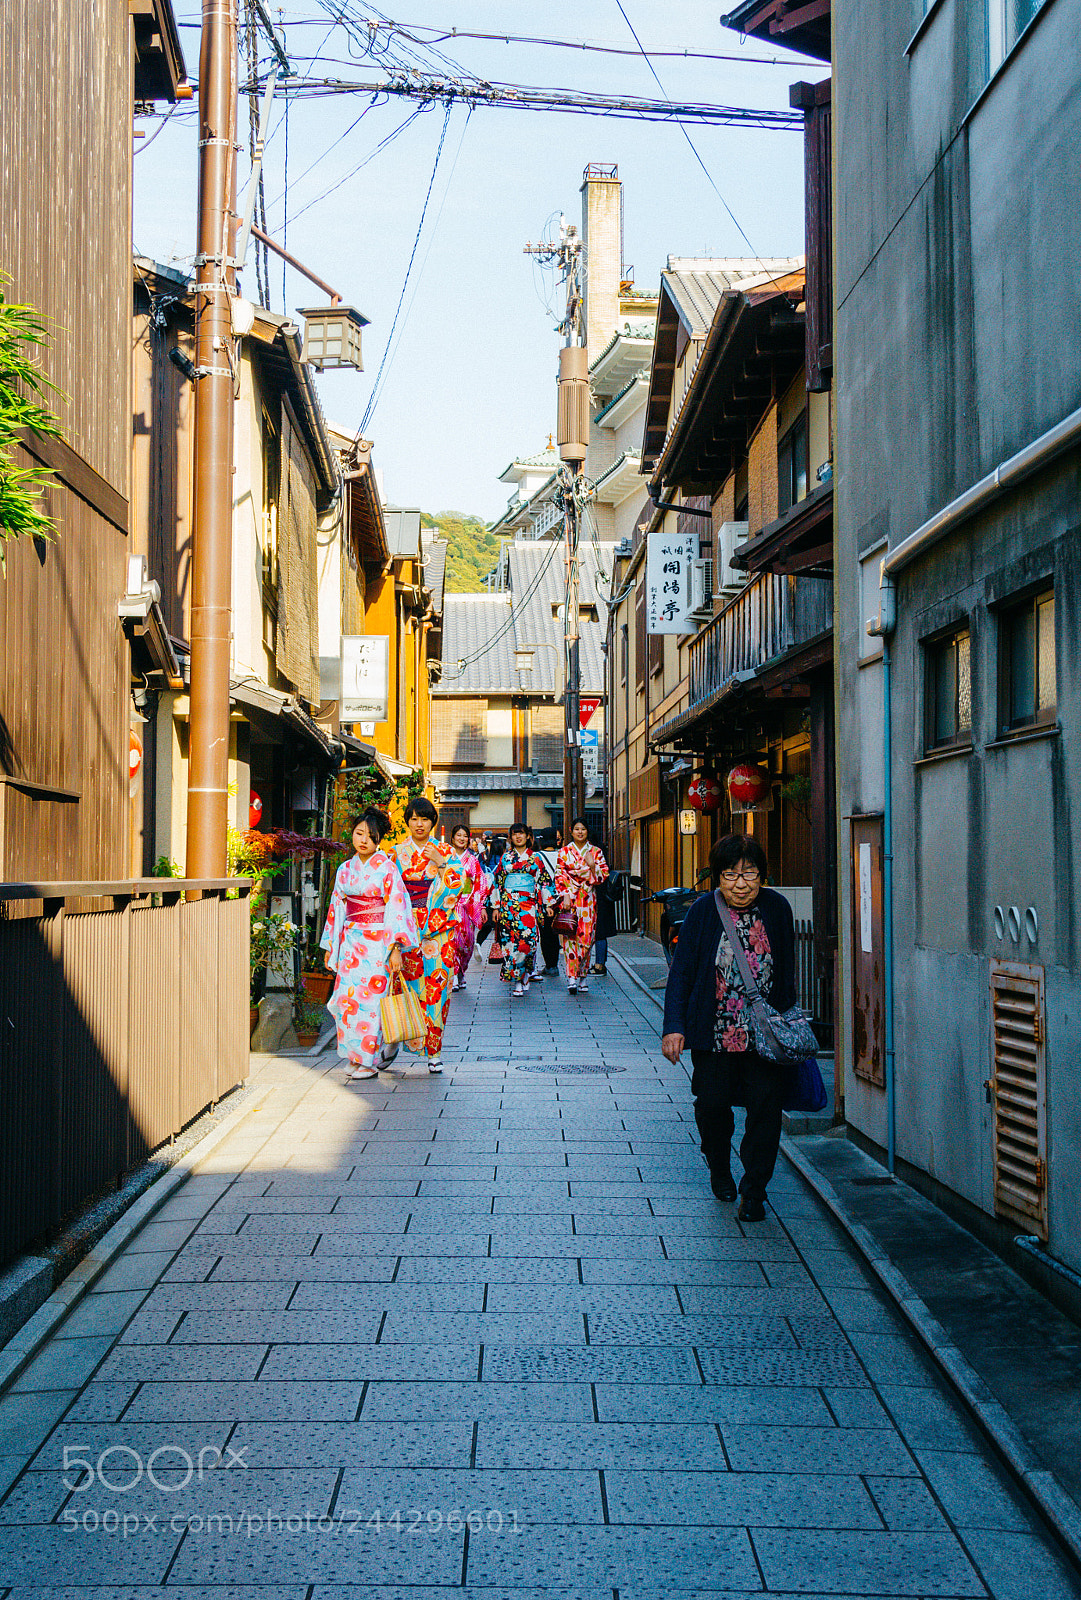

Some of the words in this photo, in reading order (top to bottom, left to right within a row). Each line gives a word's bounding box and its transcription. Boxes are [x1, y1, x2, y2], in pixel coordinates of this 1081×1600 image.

[344, 704, 383, 712] サッポロビール
